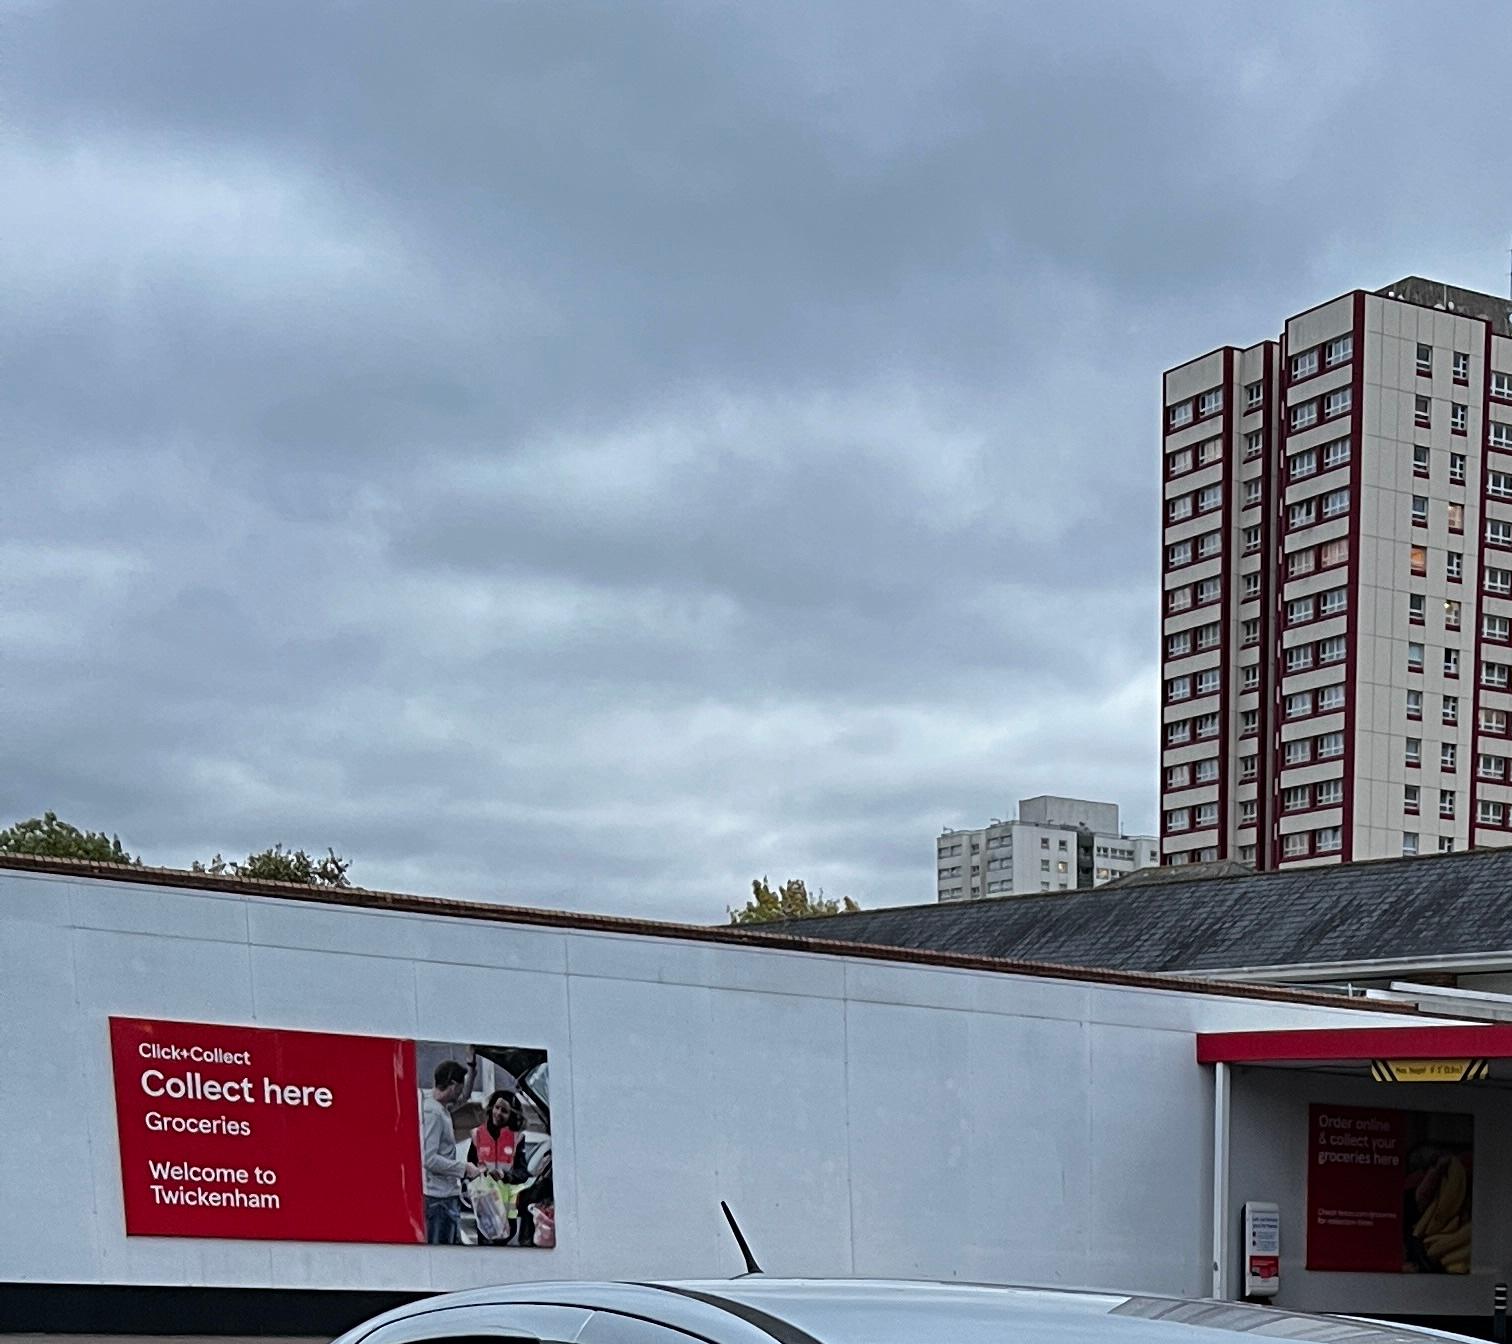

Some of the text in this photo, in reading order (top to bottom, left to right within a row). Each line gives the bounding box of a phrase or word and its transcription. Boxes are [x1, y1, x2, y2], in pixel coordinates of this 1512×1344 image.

[138, 1041, 251, 1066] Click+Collect
[140, 1069, 334, 1108] Collect here
[145, 1111, 251, 1137] Groceries
[1319, 1114, 1391, 1132] Order online
[1329, 1132, 1369, 1148] collect
[1371, 1137, 1397, 1153] your
[1318, 1150, 1400, 1166] groceries here
[148, 1159, 277, 1185] Welcome to
[150, 1184, 280, 1210] Twickenham
